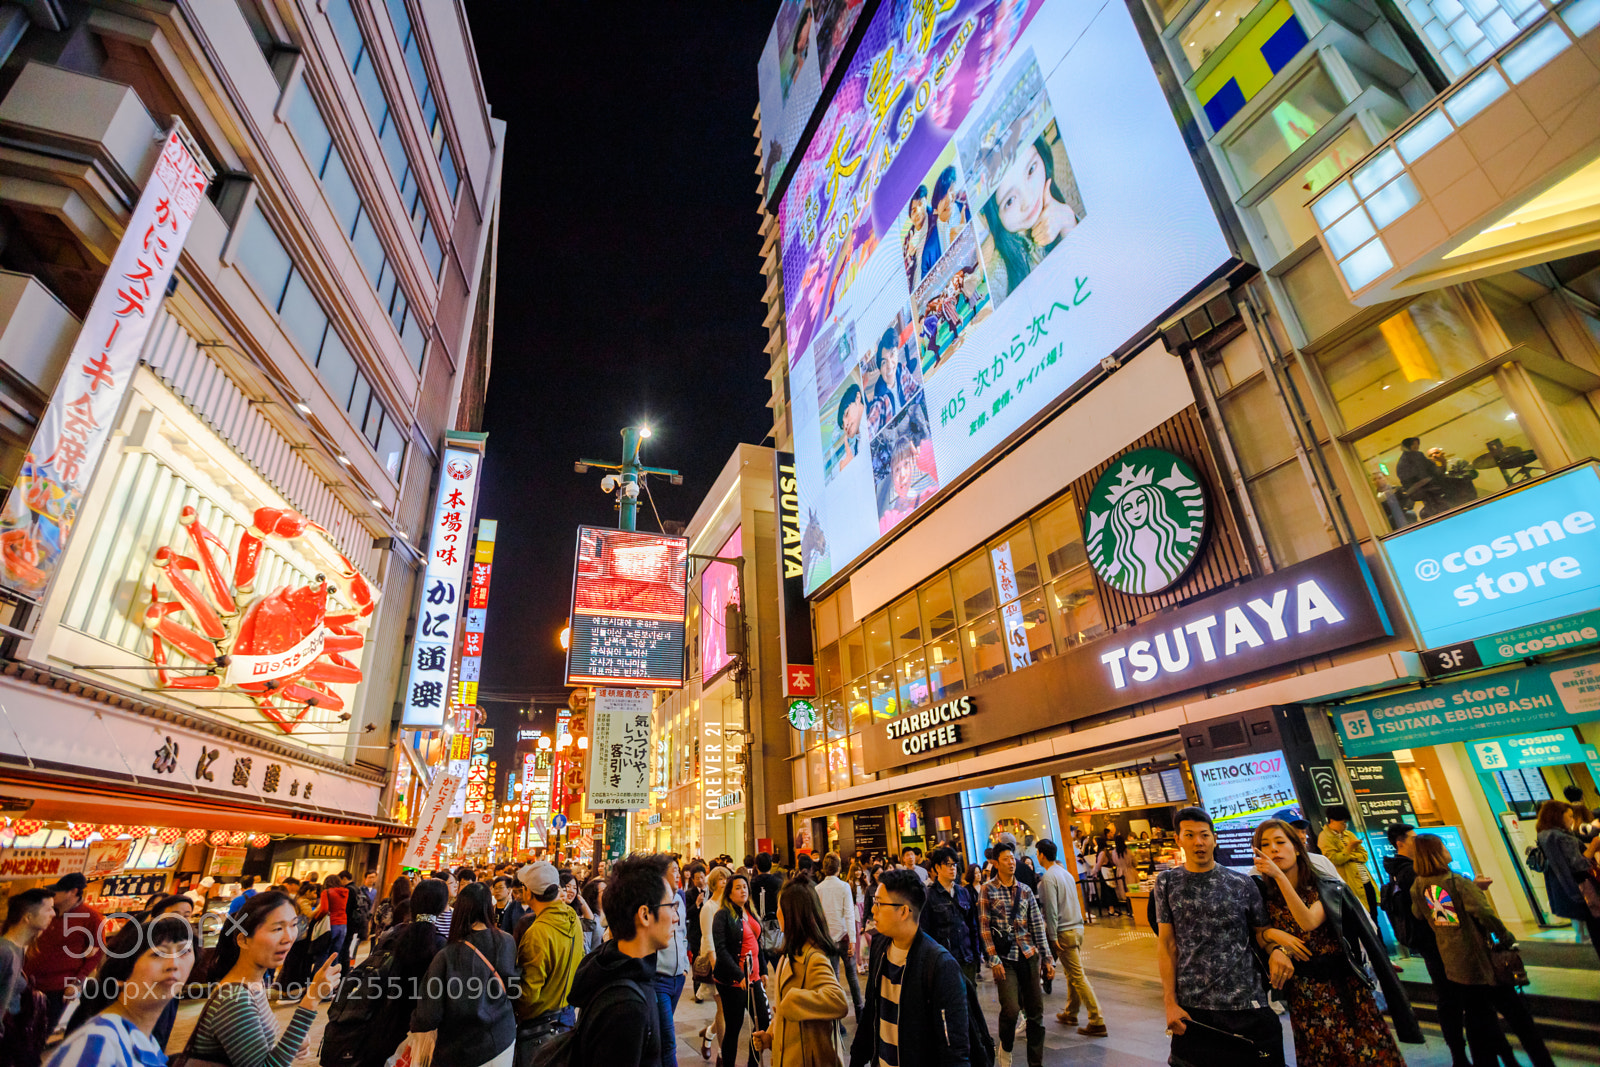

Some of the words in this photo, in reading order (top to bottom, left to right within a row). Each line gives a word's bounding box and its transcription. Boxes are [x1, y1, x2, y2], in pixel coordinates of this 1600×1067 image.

[43, 196, 178, 482] かにステーキ会席
[940, 390, 966, 427] #05
[973, 276, 1092, 398] 次から次へと
[436, 488, 466, 566] 本場の味
[779, 461, 803, 579] TSUTAYA
[1415, 510, 1597, 582] @cosme
[1452, 556, 1582, 607] store
[411, 580, 456, 709] かに道楽
[1101, 579, 1345, 689] TSUTAYA
[1438, 649, 1464, 669] 3F
[1498, 626, 1598, 657] @cosme
[792, 670, 811, 691] 本
[1372, 695, 1446, 720] @cosme
[1452, 685, 1510, 706] store
[705, 722, 721, 736] 21
[886, 695, 973, 740] STARBUCKS
[1348, 718, 1368, 737] 3F
[1377, 714, 1442, 735] TSUTAYA
[1446, 694, 1553, 723] EBISUBASHI
[623, 722, 634, 767] しつこい
[901, 723, 957, 757] COFFEE
[1485, 753, 1499, 766] 3F
[1508, 733, 1565, 748] @cosme
[1521, 745, 1561, 757] store
[610, 743, 623, 788] 客引き
[705, 744, 722, 820] FOREVER
[1200, 757, 1282, 782] METROCK2017
[413, 777, 453, 858] かにステーキ会席
[1209, 788, 1296, 820] チケット販売中!
